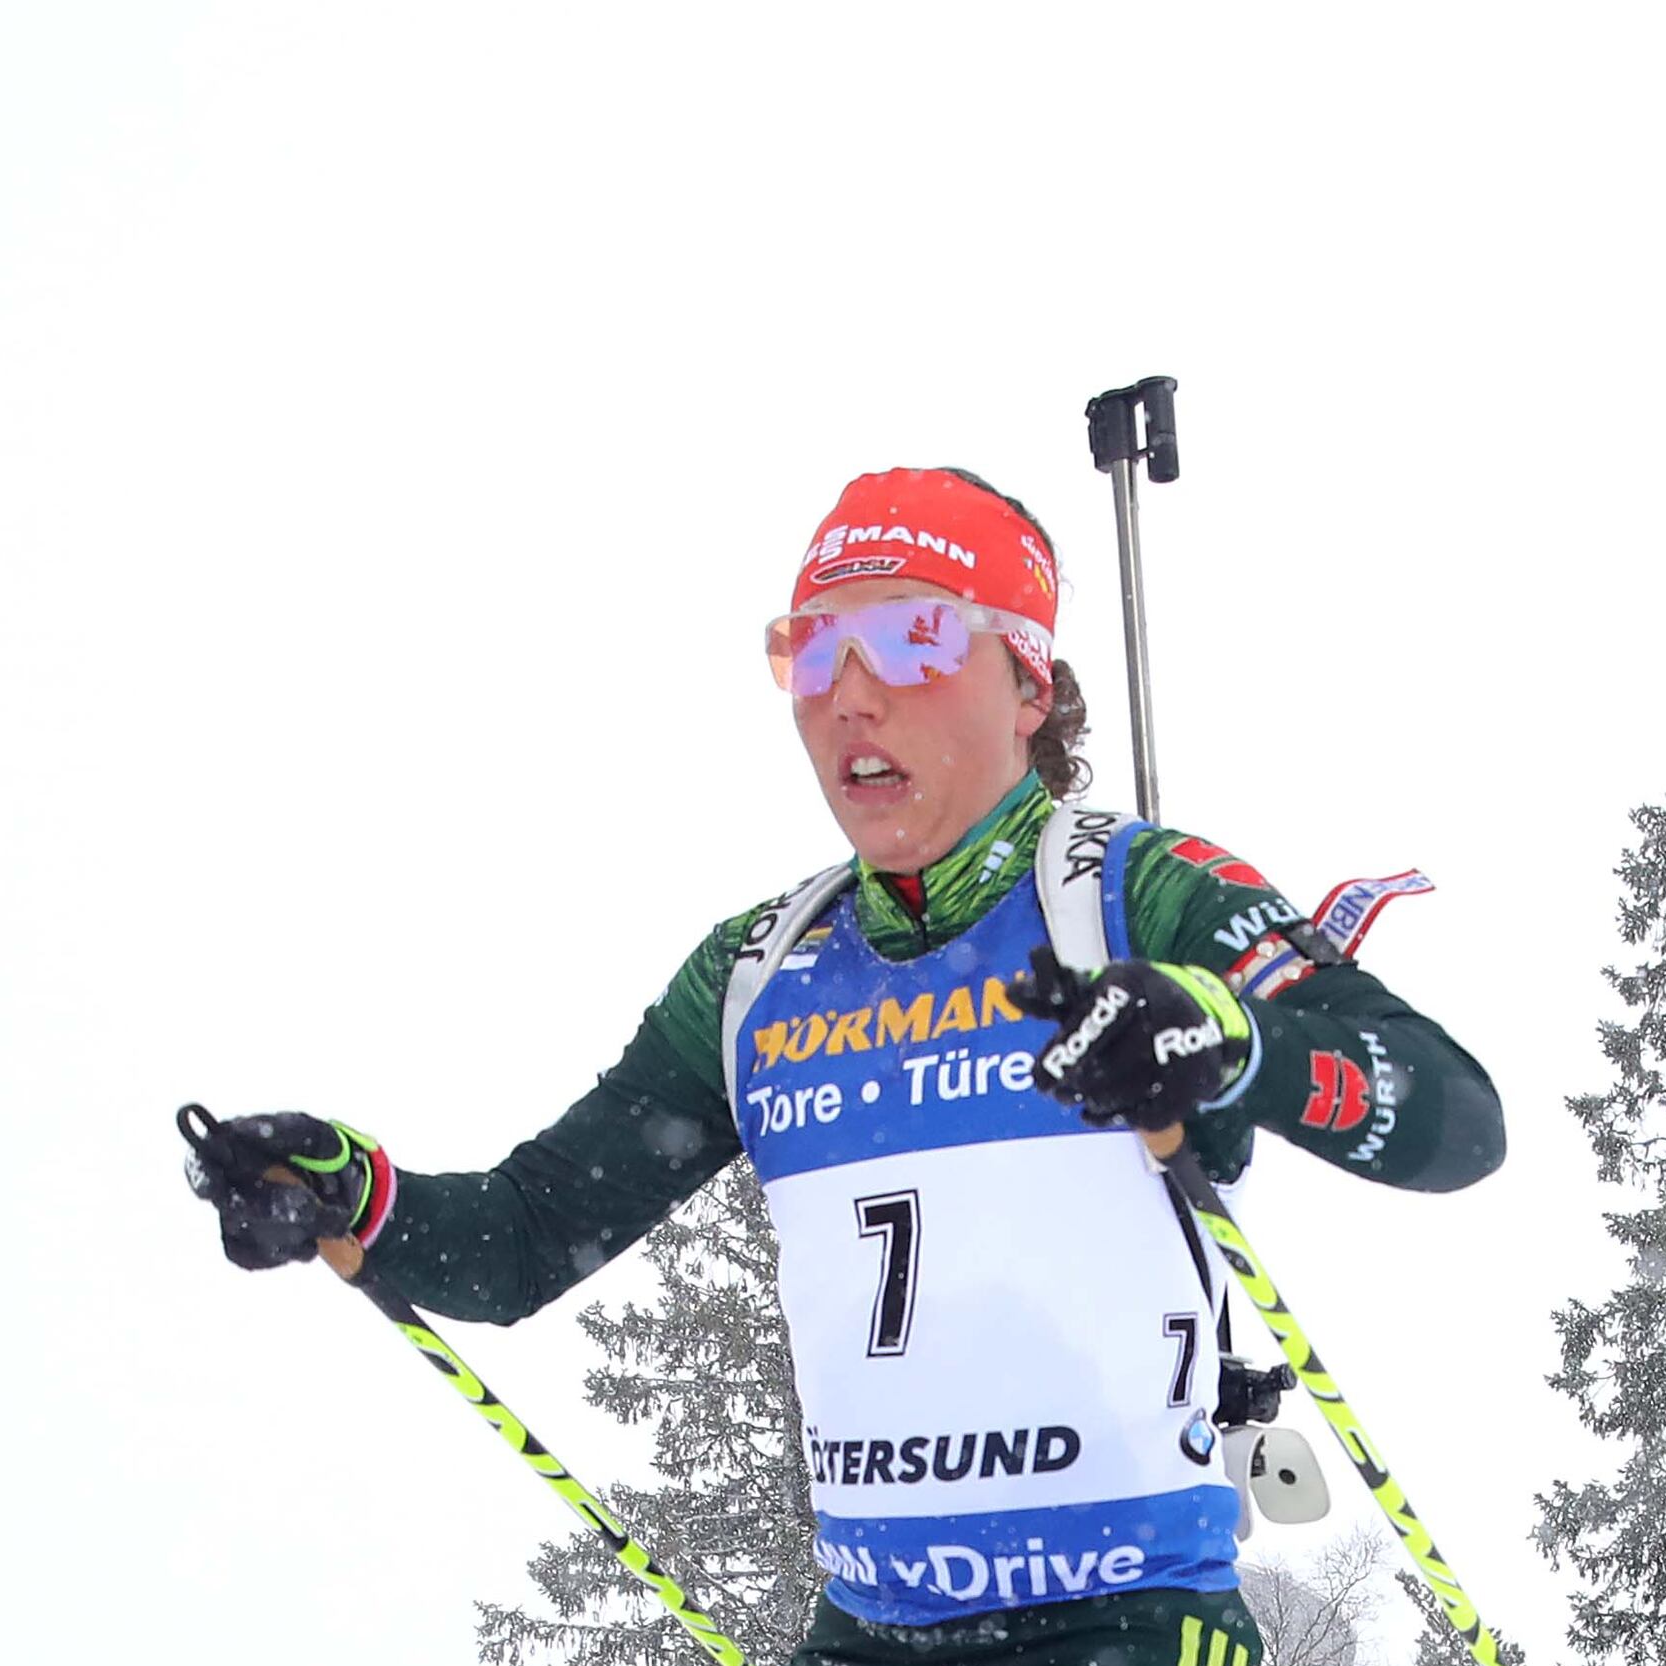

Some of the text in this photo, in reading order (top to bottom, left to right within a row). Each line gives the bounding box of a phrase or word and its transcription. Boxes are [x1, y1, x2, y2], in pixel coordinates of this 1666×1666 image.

[903, 1048, 1035, 1106] Türe
[855, 1188, 923, 1359] 7
[1163, 1312, 1199, 1409] 7
